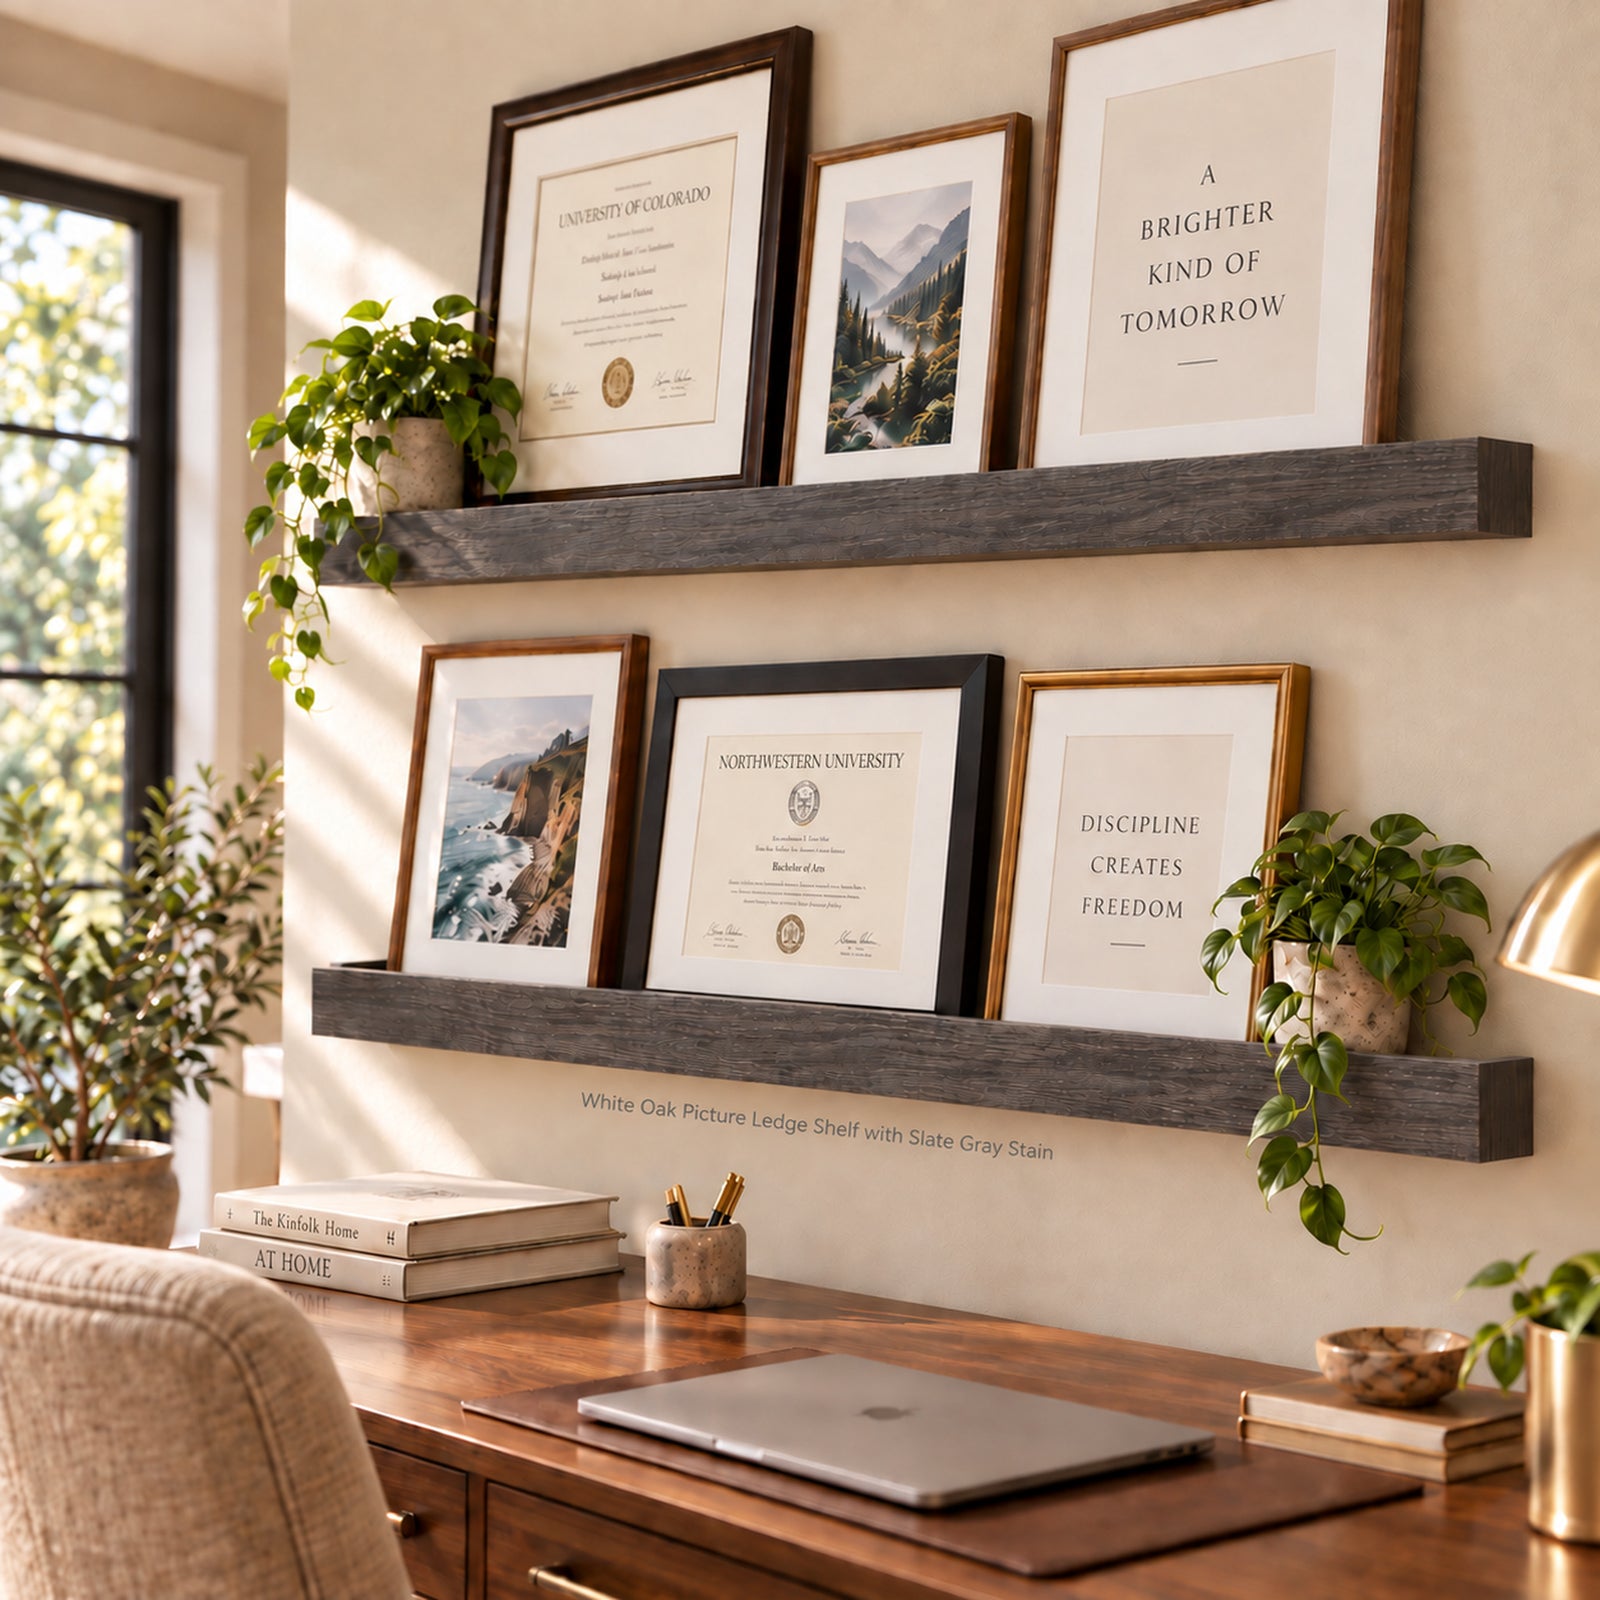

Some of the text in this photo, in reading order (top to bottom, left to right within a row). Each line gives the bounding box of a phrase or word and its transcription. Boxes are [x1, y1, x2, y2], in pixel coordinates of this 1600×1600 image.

[1200, 165, 1215, 185] A
[558, 202, 623, 229] UNIVERSITY
[625, 199, 642, 216] OF
[643, 186, 711, 213] COLORADO
[1141, 200, 1274, 240] BRIGHTER
[1148, 250, 1260, 285] KIND OF
[1120, 294, 1286, 334] TOMORROW
[719, 753, 904, 769] NORTHWESTERN UNIVERSITY
[1081, 814, 1200, 834] DISCIPLINE
[1090, 855, 1183, 876] CREATES
[1082, 897, 1183, 919] FREEDOM
[253, 1210, 359, 1240] The Kinfolk Home
[254, 1249, 332, 1279] AT HOME
